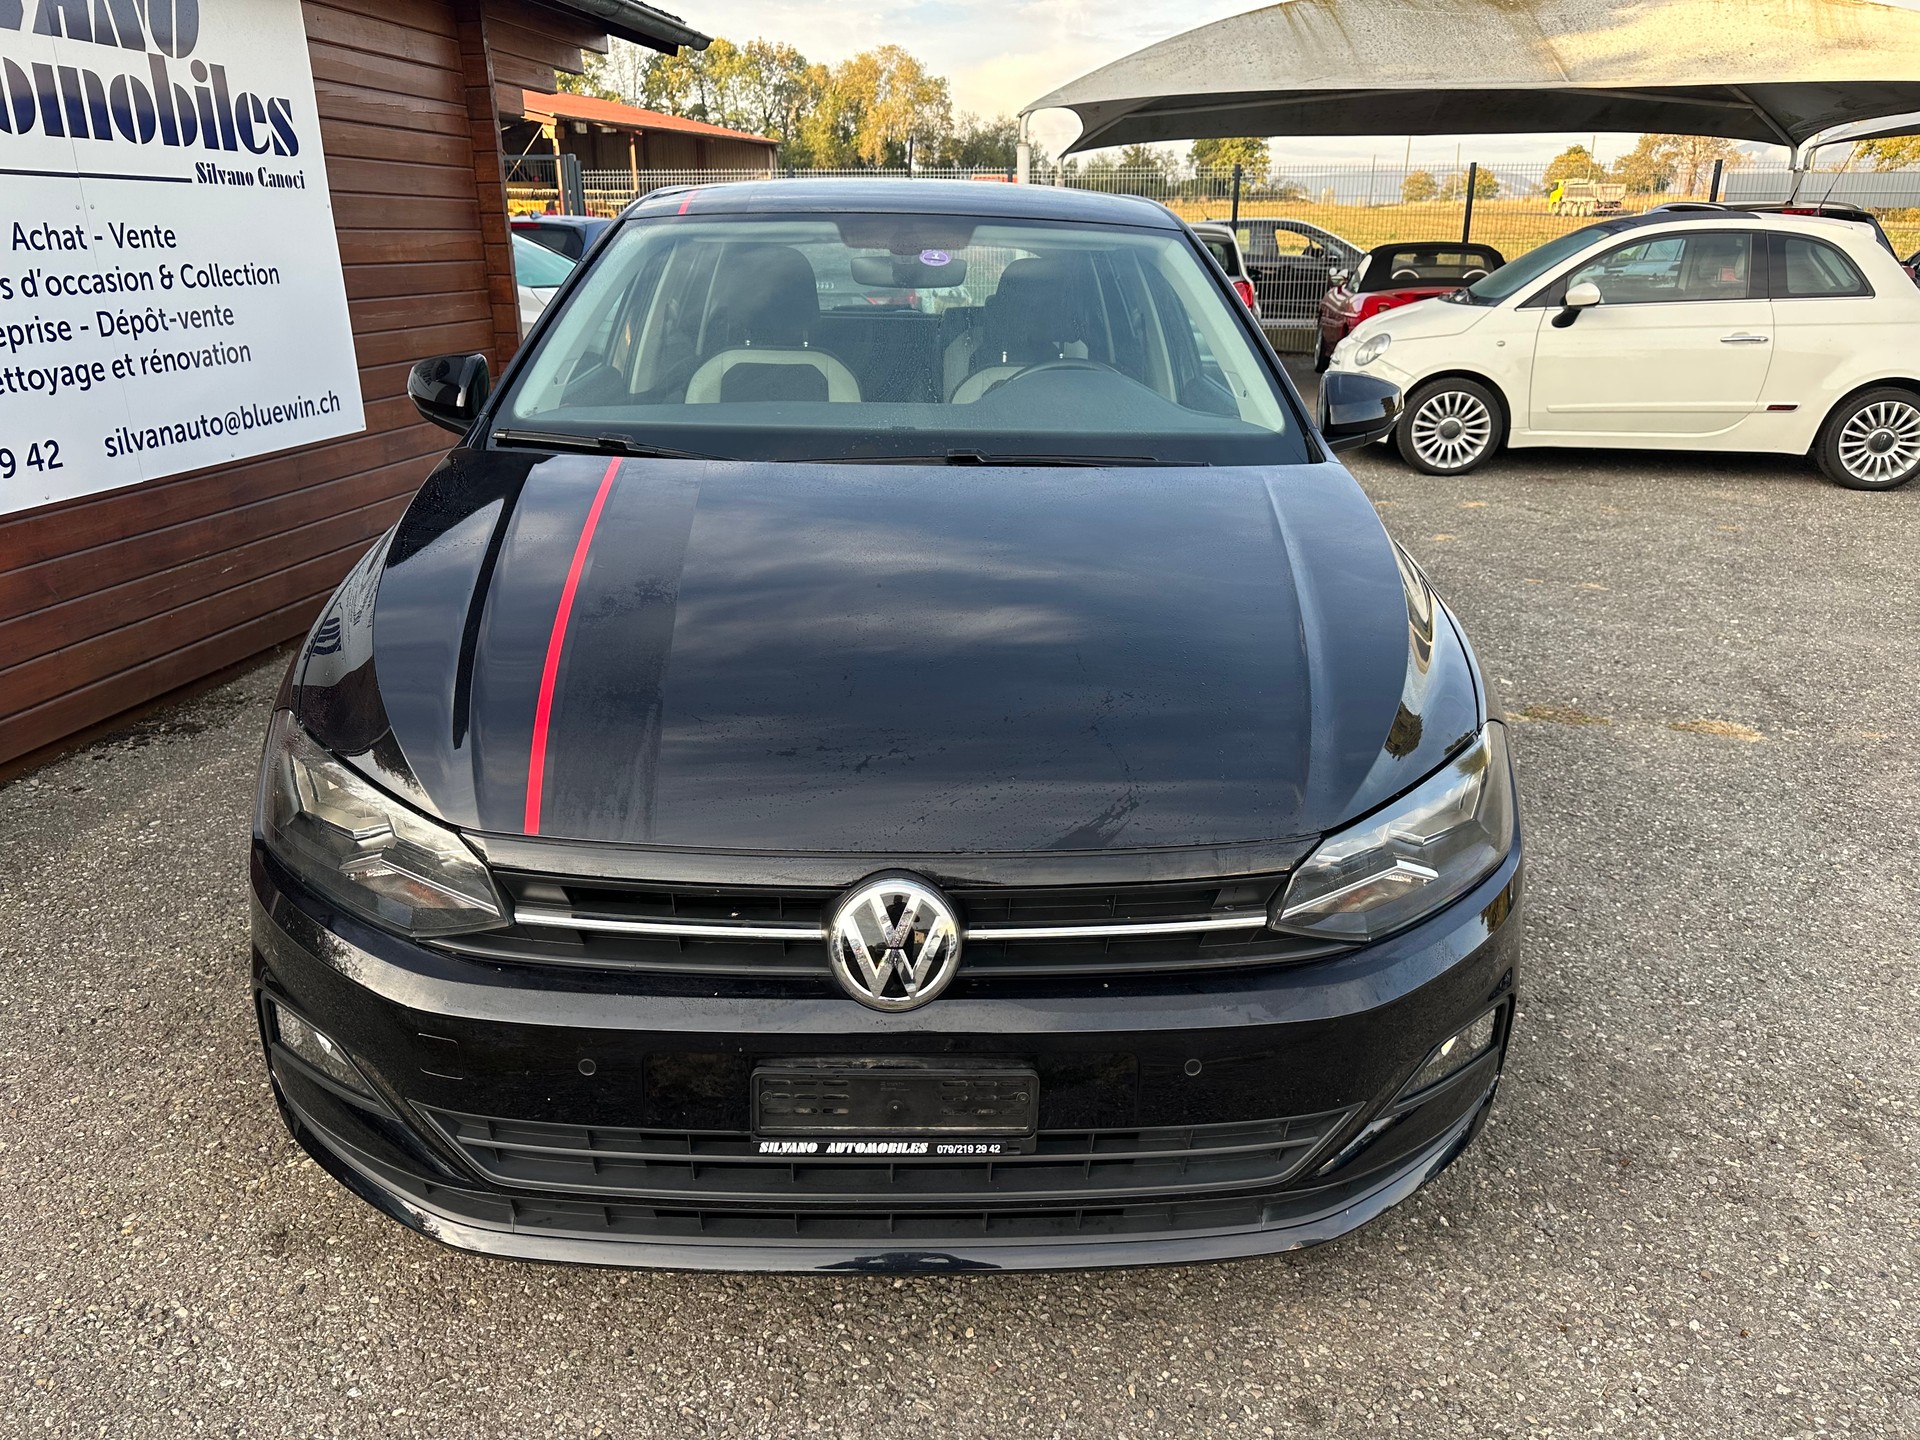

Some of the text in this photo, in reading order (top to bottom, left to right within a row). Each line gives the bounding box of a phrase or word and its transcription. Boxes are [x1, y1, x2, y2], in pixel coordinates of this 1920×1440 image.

[0, 0, 199, 59] ANO
[195, 162, 305, 189] Silvano Canoci
[11, 222, 88, 251] Achat
[107, 222, 177, 249] Vente
[20, 266, 154, 298] d'occasion
[160, 264, 174, 289] &
[180, 262, 280, 289] Collection
[96, 305, 235, 340] Dépôt-vente
[112, 354, 136, 379] et
[140, 342, 251, 375] rénovation
[26, 439, 63, 473] 42
[104, 390, 341, 457] silvanauto@bluewin.ch
[759, 1142, 1001, 1155] SILVANO AUTOMOBILES 079/219 29 42
